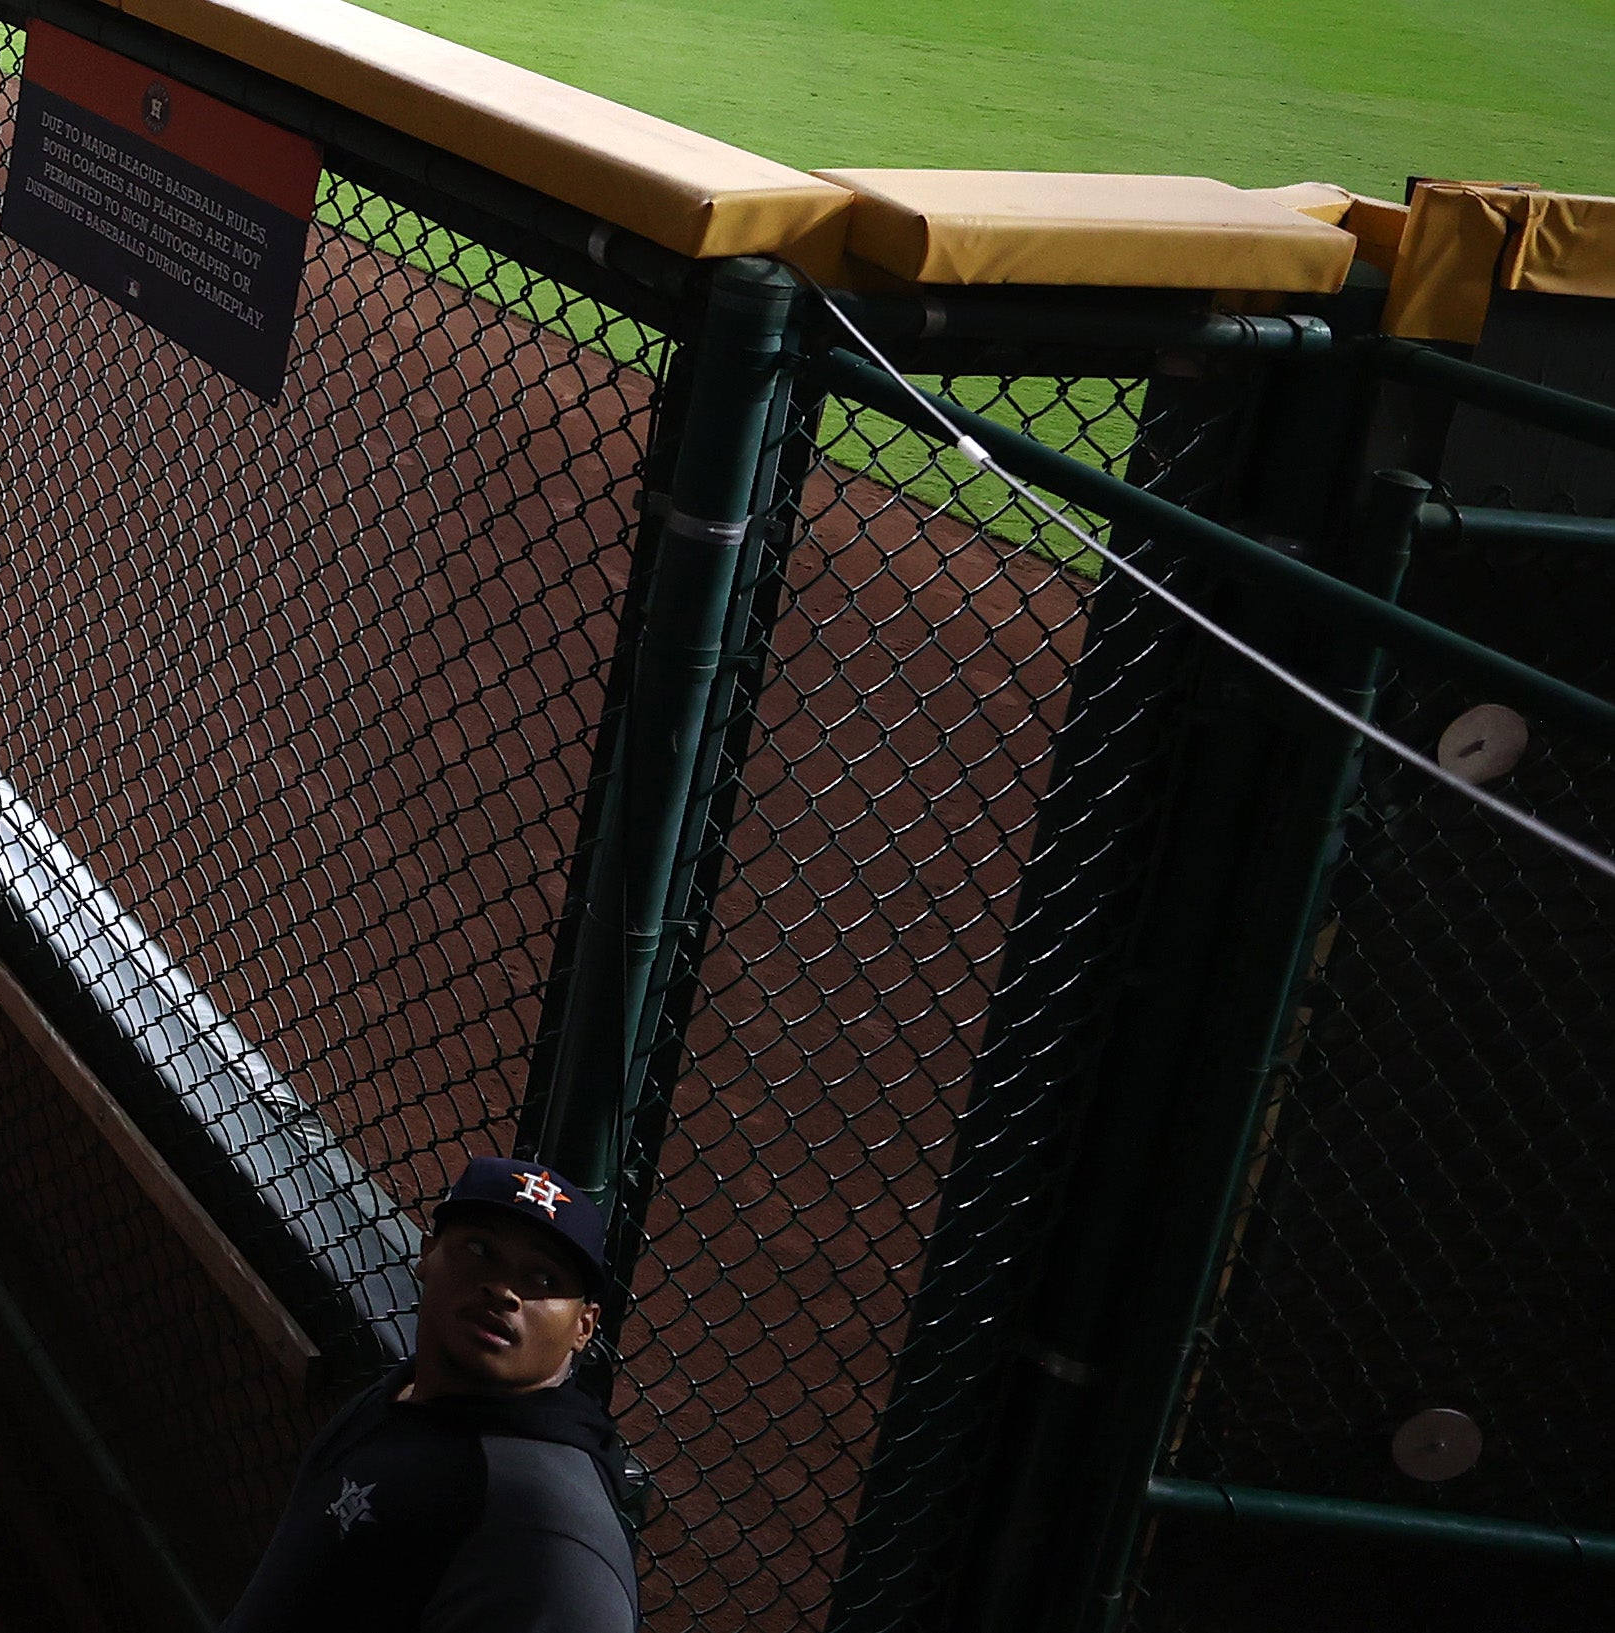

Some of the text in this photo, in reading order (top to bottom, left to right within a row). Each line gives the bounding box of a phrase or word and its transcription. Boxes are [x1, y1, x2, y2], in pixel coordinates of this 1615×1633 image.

[41, 111, 64, 135] DUE
[65, 123, 80, 143] TO
[81, 132, 117, 164] MAJOR
[118, 151, 163, 189] LEAGUE
[165, 177, 223, 221] BASEBALL
[42, 136, 261, 270] BOTH COACHES AND PLAYERS ARE NOT
[43, 162, 252, 294] PERMITTED TO SIGN AUTOGRAPHS OR
[25, 176, 265, 331] DISTRIBUTE BASEBALLS DURING GAMEPLAY.
